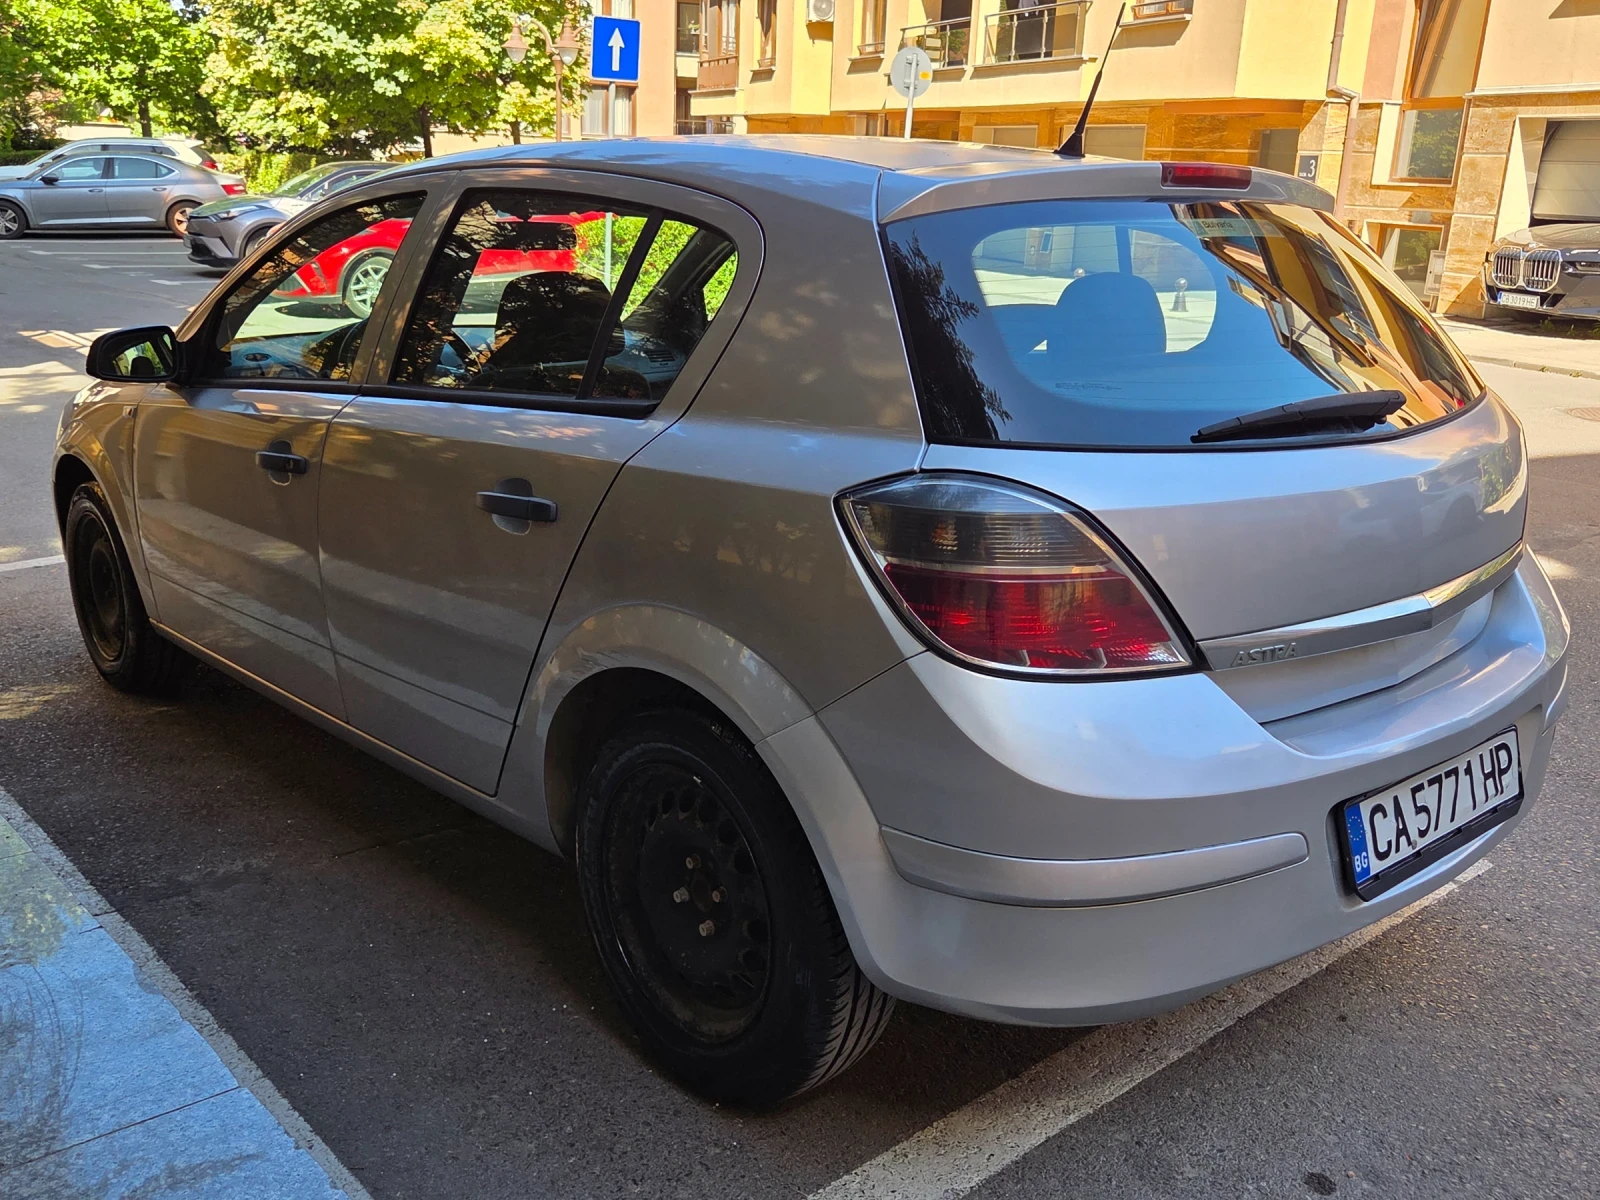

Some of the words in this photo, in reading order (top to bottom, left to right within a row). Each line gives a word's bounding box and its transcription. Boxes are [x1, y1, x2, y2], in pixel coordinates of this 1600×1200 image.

[1307, 159, 1316, 178] 3
[1230, 642, 1298, 667] ASTRA
[1354, 851, 1369, 872] BG
